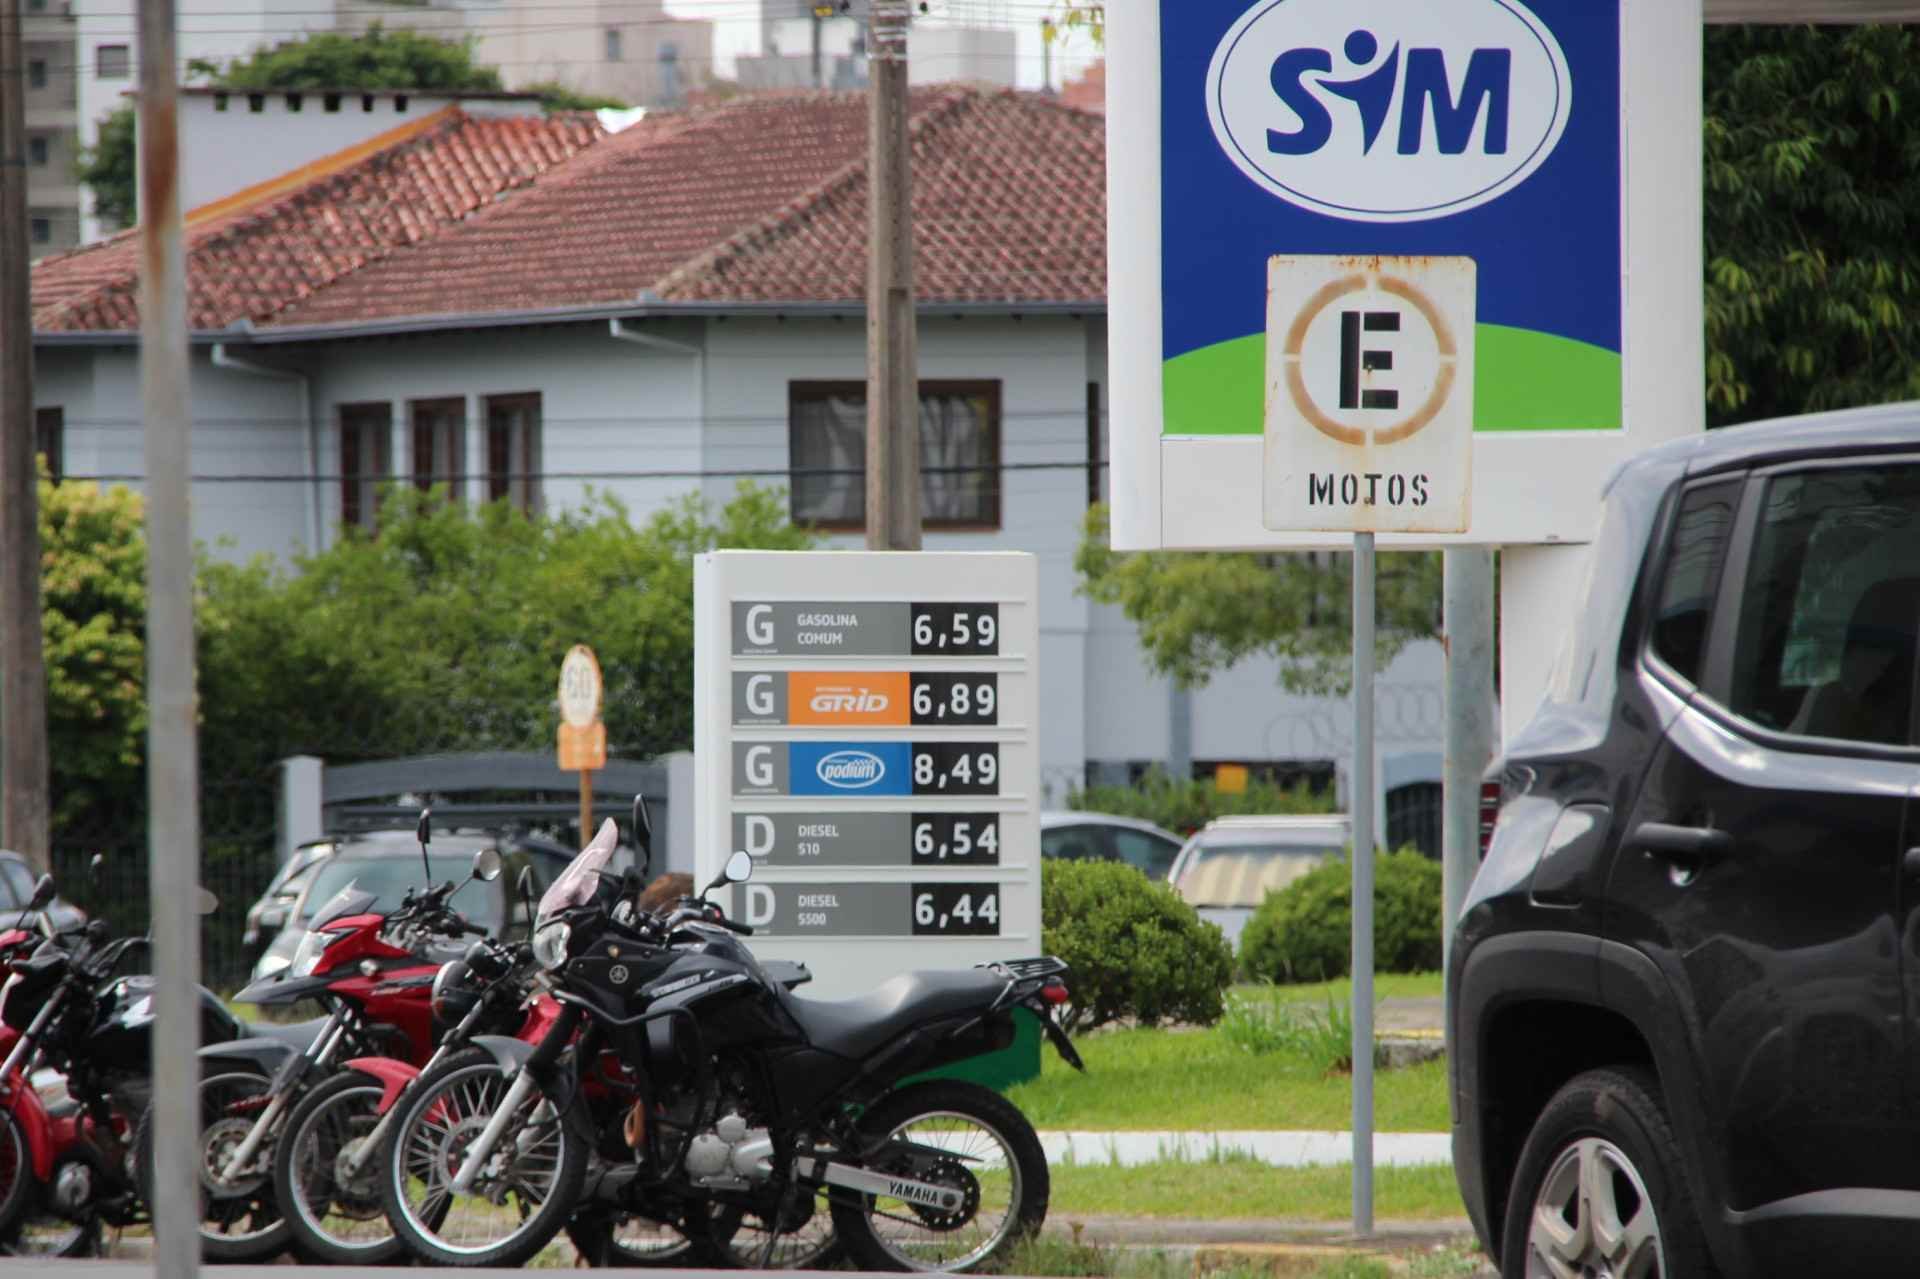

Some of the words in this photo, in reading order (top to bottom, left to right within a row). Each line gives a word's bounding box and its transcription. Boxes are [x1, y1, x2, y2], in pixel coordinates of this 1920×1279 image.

[1266, 30, 1511, 156] SIM
[1339, 311, 1400, 410] E
[1308, 473, 1429, 506] MOTOS
[745, 604, 774, 646] G
[797, 613, 858, 627] GASOLINA
[914, 613, 996, 648] 6,59
[797, 632, 843, 645] COMUM
[745, 674, 774, 715] G
[913, 683, 995, 718] 6,89
[745, 745, 774, 787] G
[824, 759, 876, 780] podium
[914, 753, 997, 788] 8,49
[745, 815, 776, 857] D
[797, 824, 840, 838] DIESEL
[915, 823, 998, 859] 6,54
[797, 843, 821, 856] S10
[745, 885, 777, 926] D
[797, 894, 840, 908] DIESEL
[915, 894, 998, 928] 6,44
[797, 912, 827, 926] S500
[889, 1181, 938, 1205] YAMAHA
